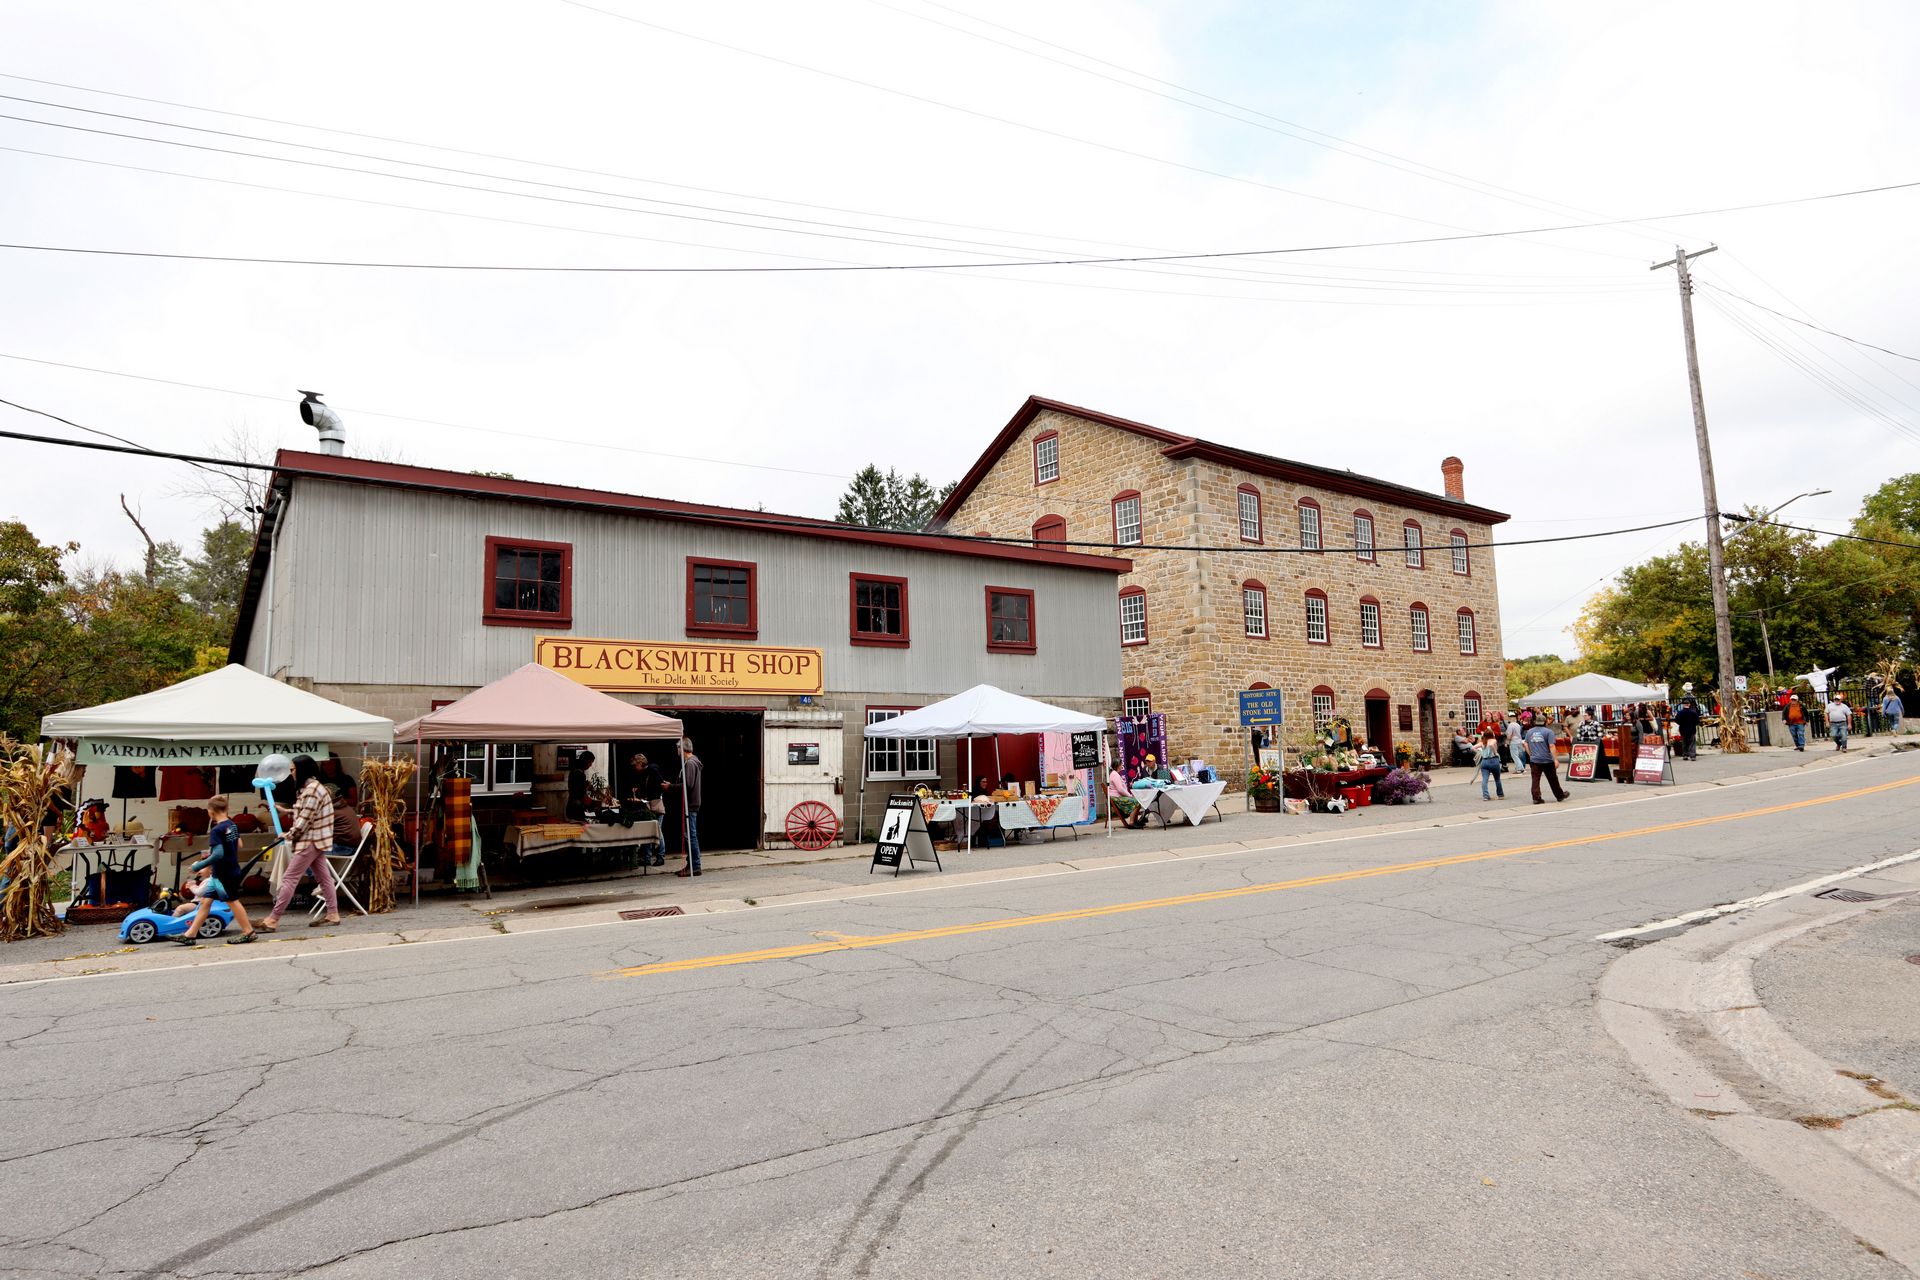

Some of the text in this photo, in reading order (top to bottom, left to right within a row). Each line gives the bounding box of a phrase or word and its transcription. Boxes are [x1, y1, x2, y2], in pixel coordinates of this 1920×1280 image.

[553, 646, 810, 675] BLACKSMITH SHOP
[642, 673, 739, 687] The Delta Mill Society
[803, 696, 812, 704] 46
[1073, 734, 1094, 744] MAGILL
[91, 742, 319, 758] WARDMAN FAMILY FARM
[880, 846, 898, 856] OPEN
